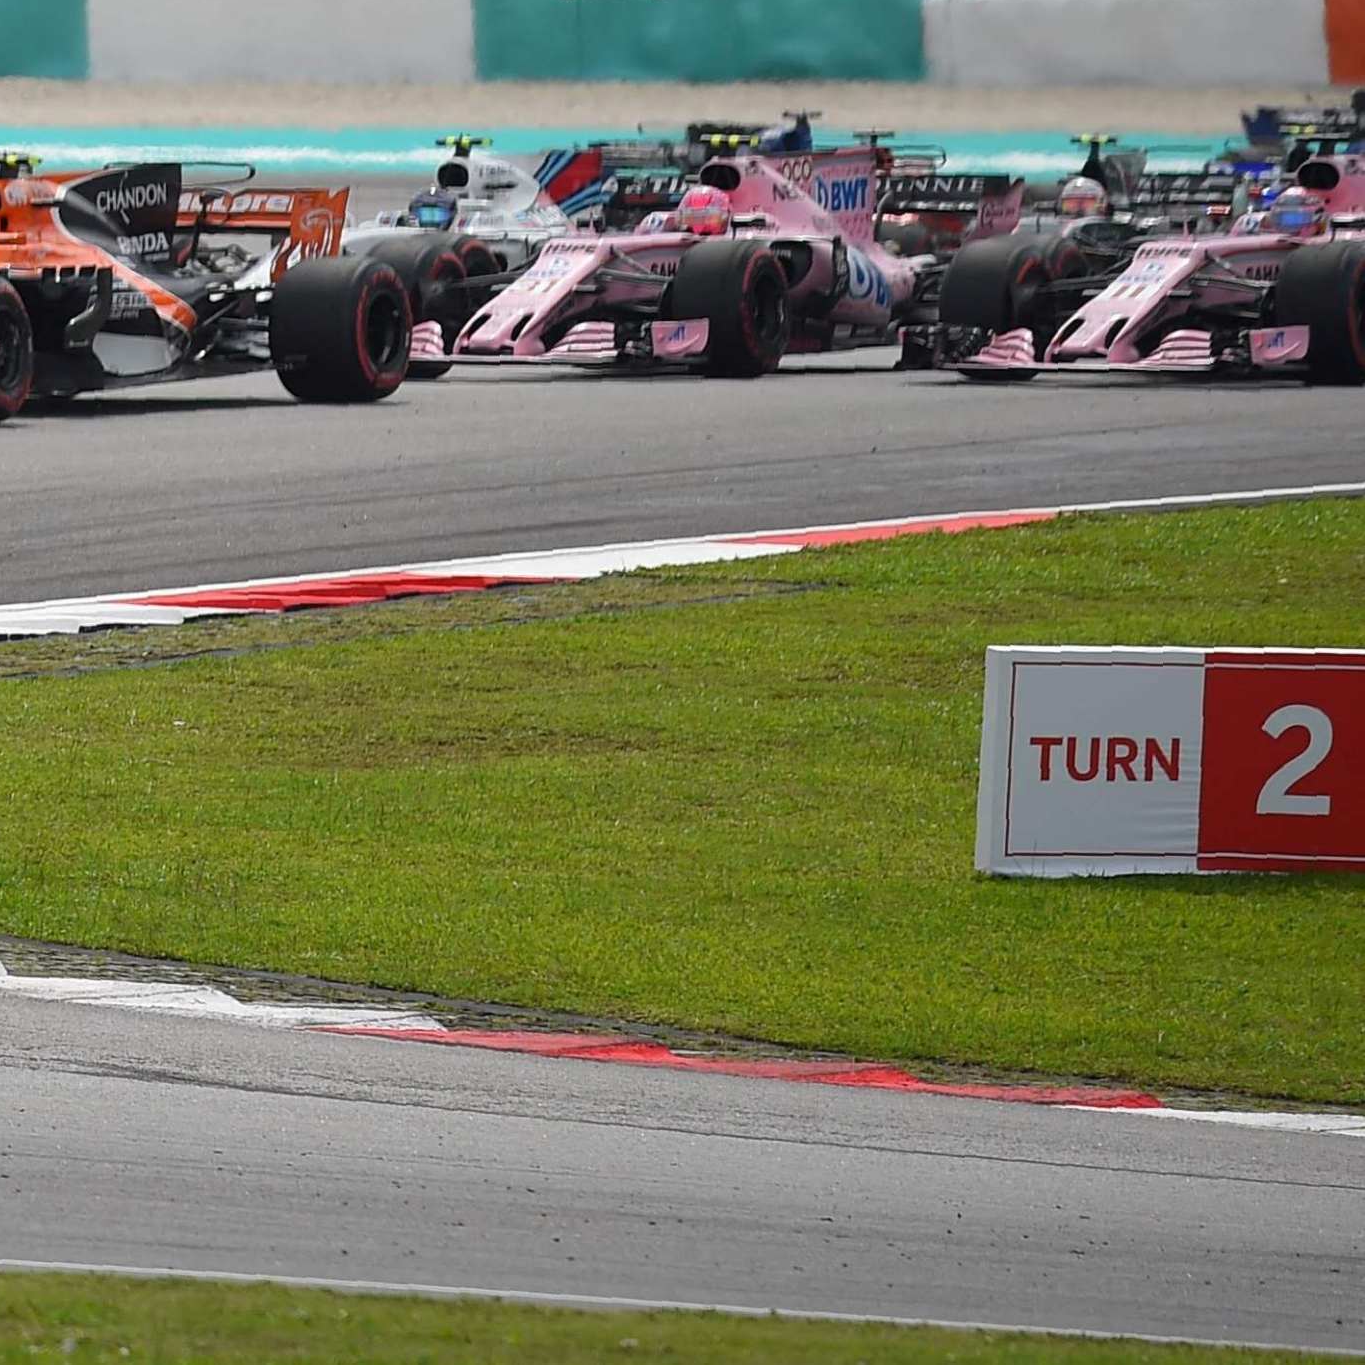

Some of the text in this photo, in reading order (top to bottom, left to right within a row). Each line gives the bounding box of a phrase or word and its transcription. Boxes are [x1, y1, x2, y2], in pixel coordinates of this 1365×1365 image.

[96, 183, 167, 213] CHANDON
[831, 177, 868, 211] BWT
[1030, 704, 1334, 816] TURN 2
